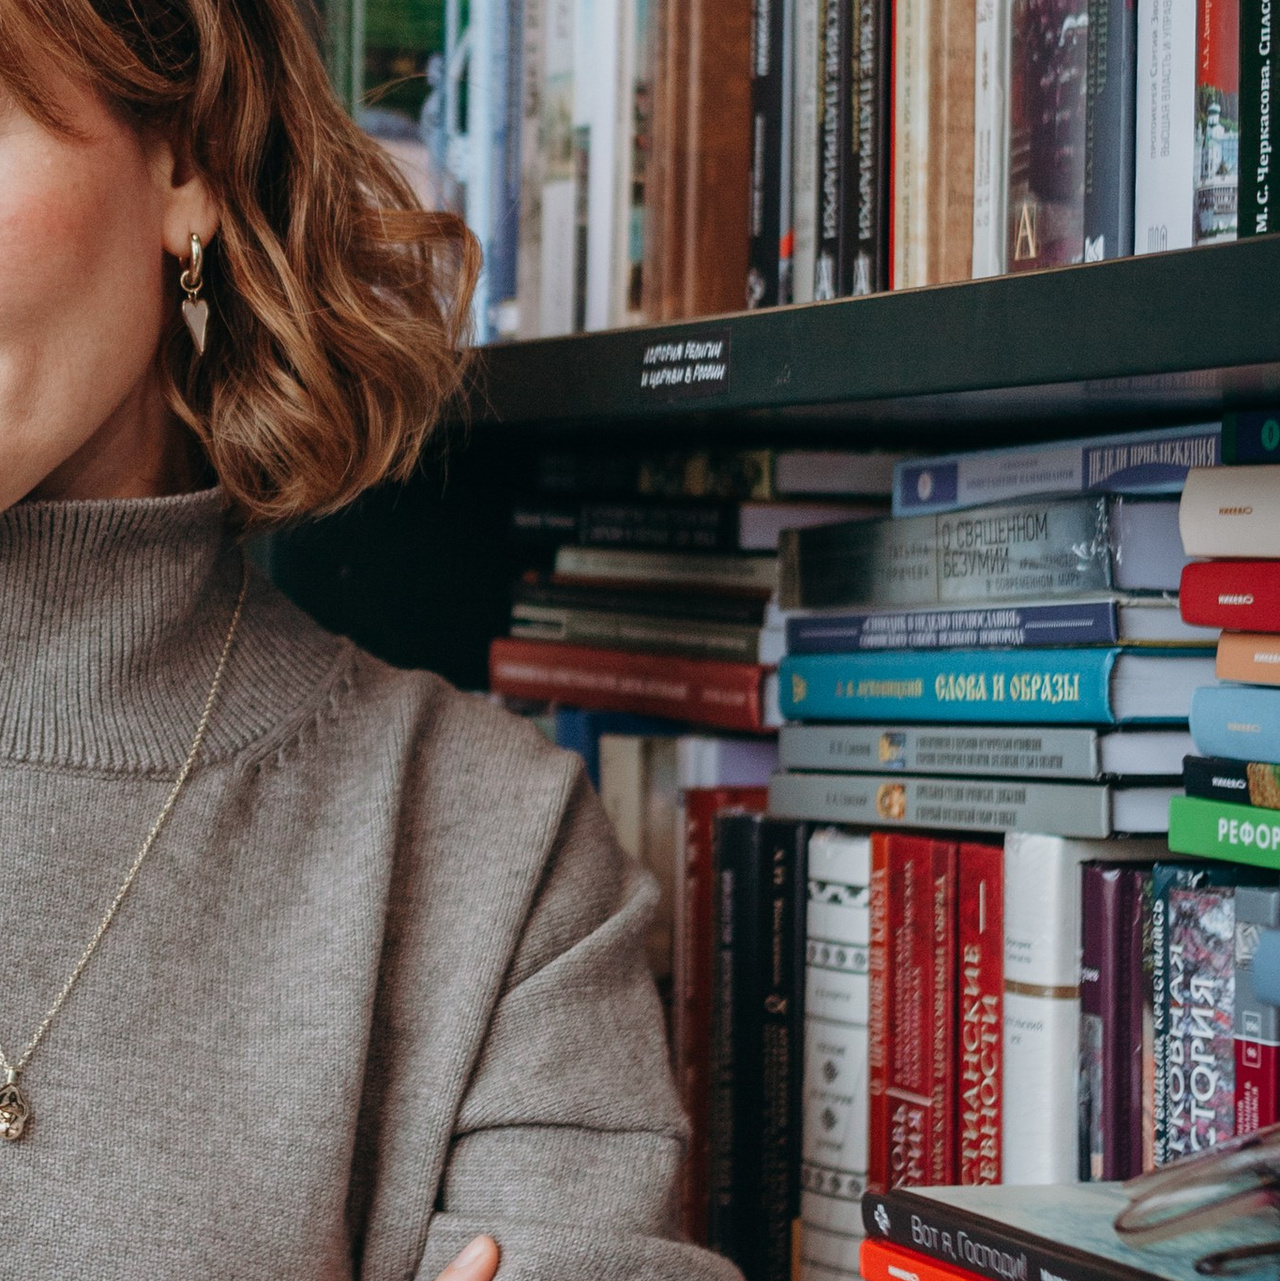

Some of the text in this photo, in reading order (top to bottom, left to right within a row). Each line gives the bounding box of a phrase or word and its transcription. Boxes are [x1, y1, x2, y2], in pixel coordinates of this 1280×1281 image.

[1162, 41, 1172, 51] И
[1161, 53, 1172, 101] ВЛАСТЬ
[1160, 104, 1171, 158] ВЫСШАЯ
[1257, 58, 1273, 183] Черкасова.
[1257, 185, 1271, 204] С.
[1256, 206, 1270, 232] М.
[1088, 435, 1217, 488] НЕДЕЛИ ПРИБЛИЖЕНИЯ
[942, 513, 1048, 549] О СВЯЩЕННОМ
[943, 547, 1010, 579] БЕЗУМИИ
[934, 672, 1080, 704] СЛОВА И ОБРАЗЫ
[1154, 898, 1167, 1030] КРЕСТИЛИСЬ
[910, 1214, 938, 1250] Вот
